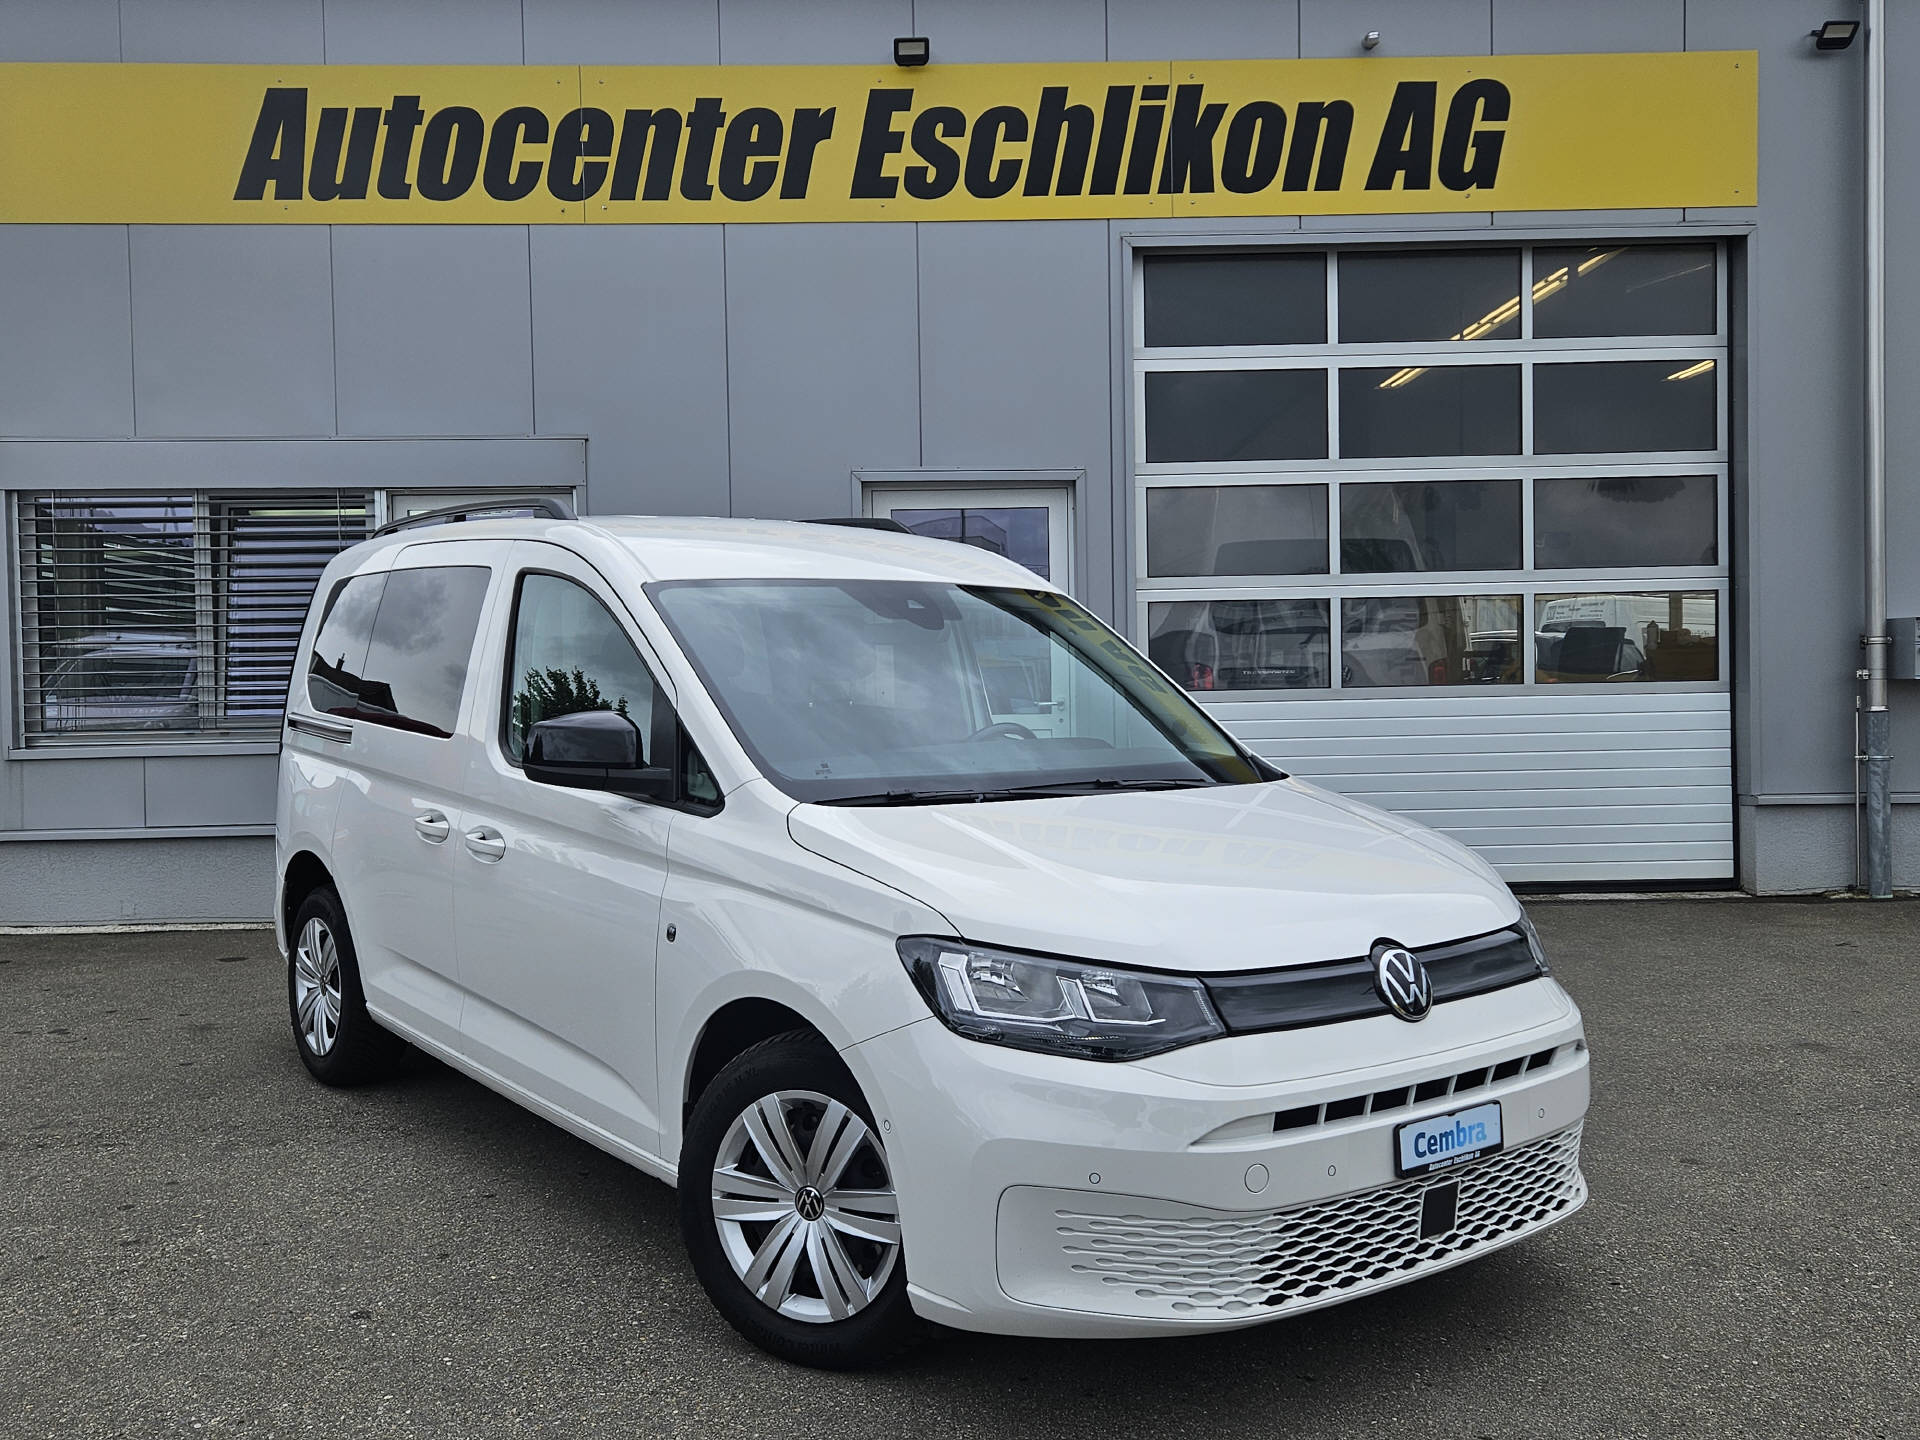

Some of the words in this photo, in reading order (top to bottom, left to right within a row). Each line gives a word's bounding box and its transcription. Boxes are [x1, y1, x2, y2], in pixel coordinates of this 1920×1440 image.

[233, 88, 837, 202] Autocenter
[849, 84, 1354, 199] Eschlikon
[1364, 79, 1511, 192] AG
[1414, 1120, 1487, 1158] Cembra
